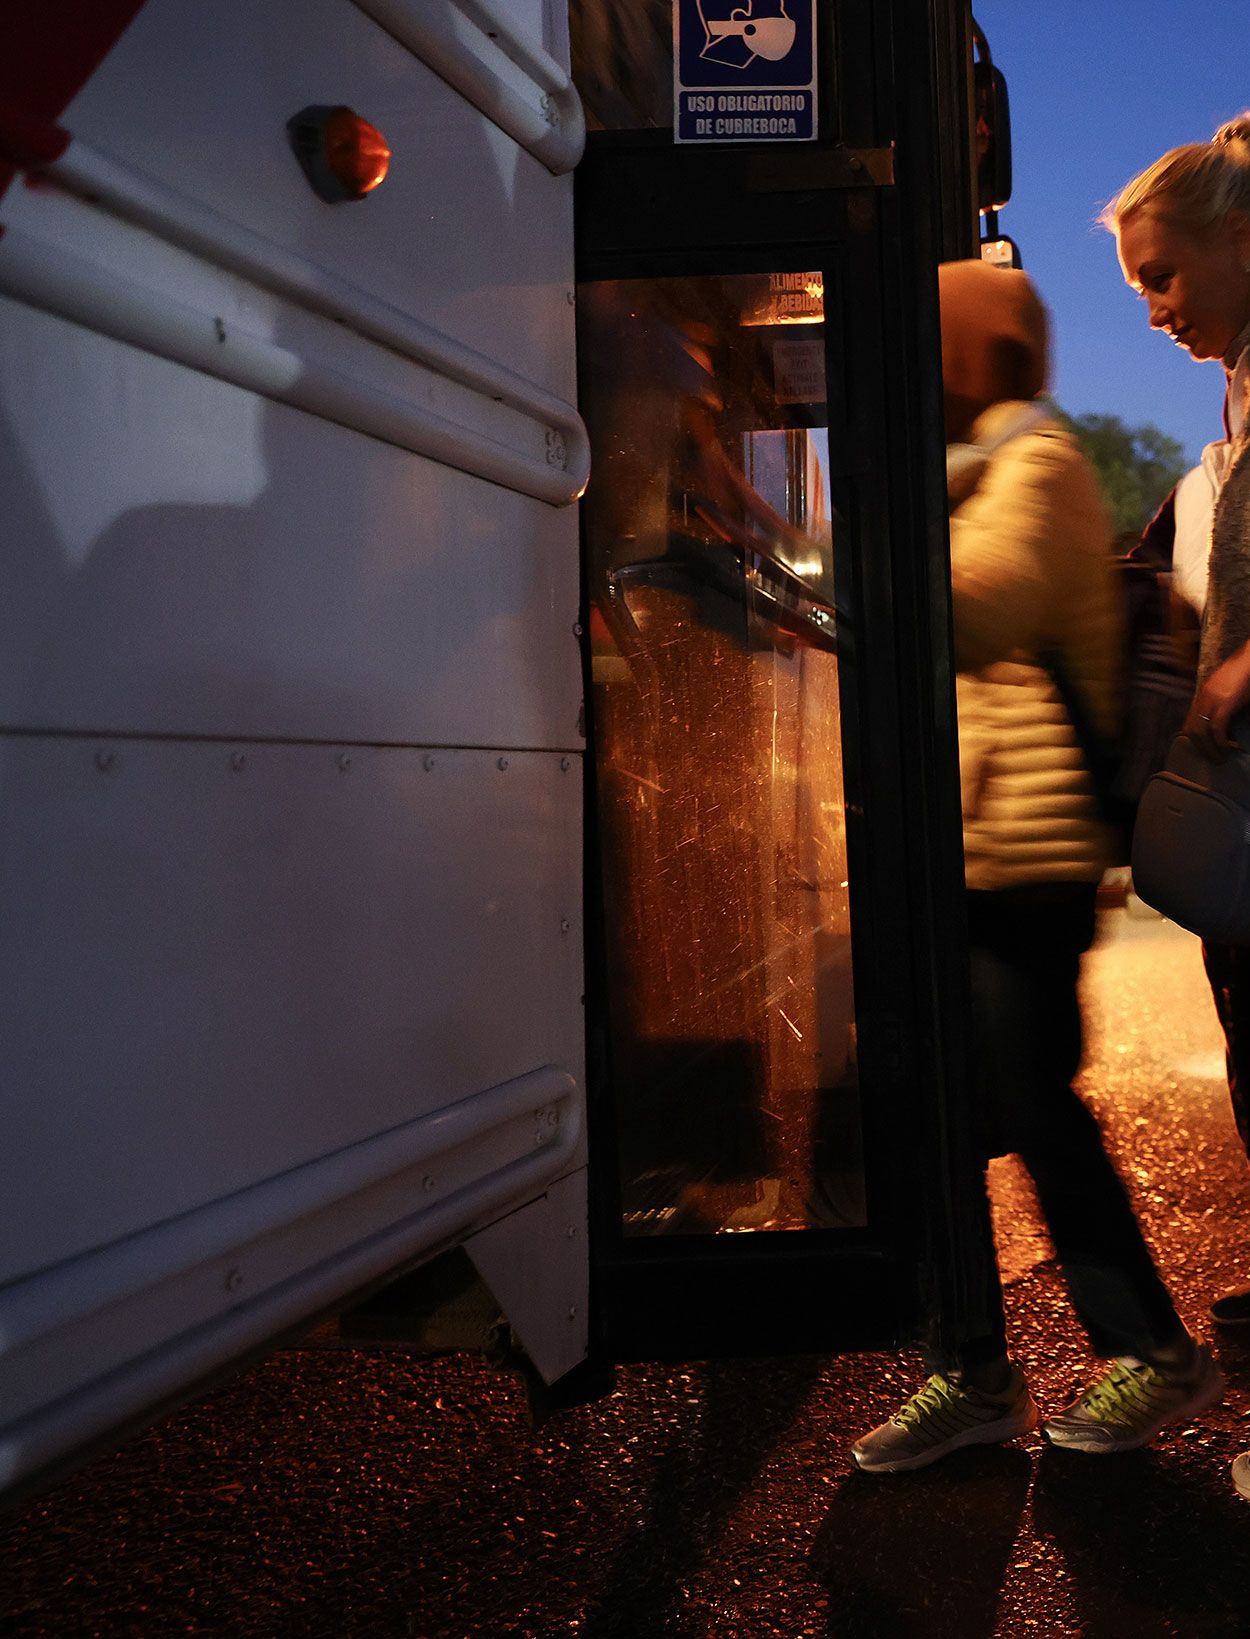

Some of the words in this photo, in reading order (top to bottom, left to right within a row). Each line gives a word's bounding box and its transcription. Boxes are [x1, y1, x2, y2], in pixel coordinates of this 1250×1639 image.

[687, 96, 715, 112] USO
[718, 95, 805, 112] OBLIGATORIO
[696, 119, 713, 134] DE
[716, 118, 796, 134] CUBREBOCA
